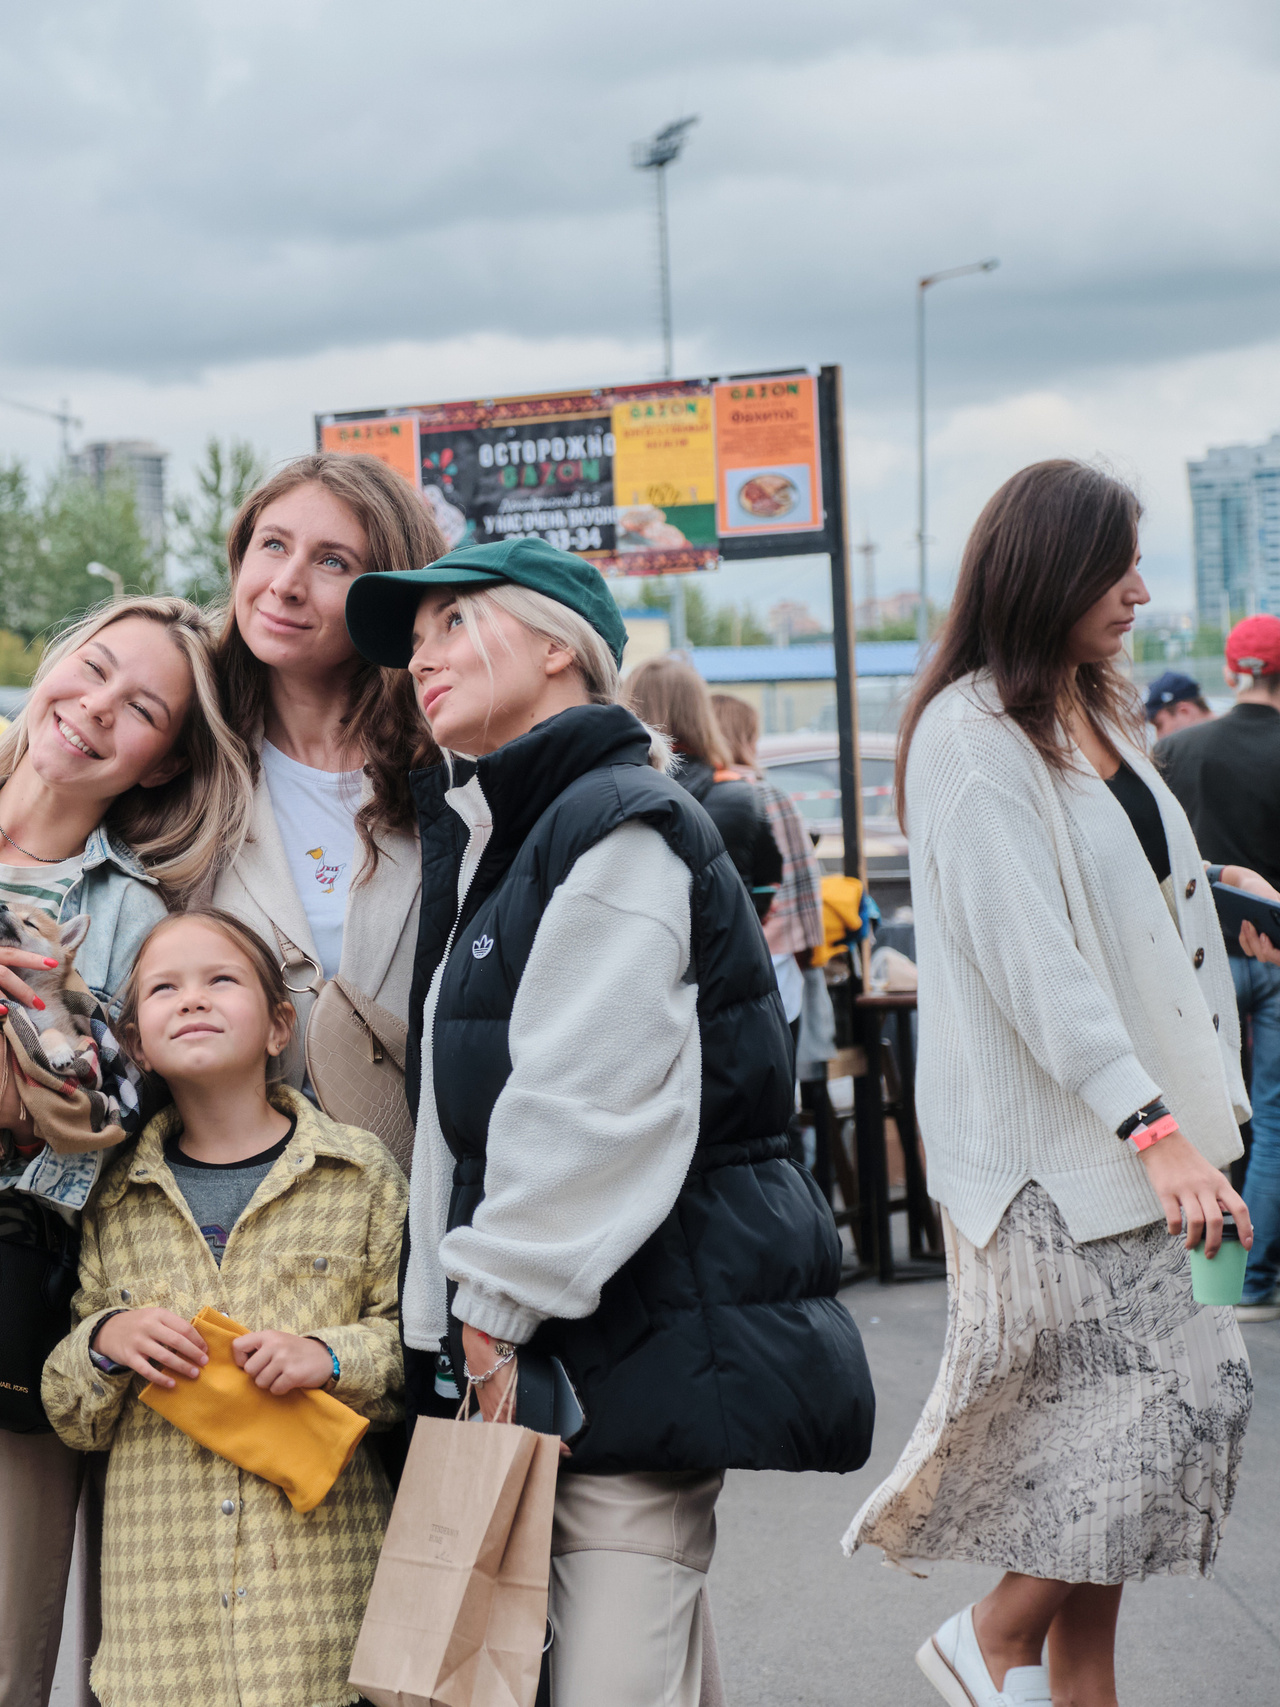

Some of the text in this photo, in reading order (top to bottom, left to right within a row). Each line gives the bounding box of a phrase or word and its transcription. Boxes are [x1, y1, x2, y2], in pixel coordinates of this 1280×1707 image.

[478, 432, 616, 468] ОСТОРОЖНО
[498, 460, 600, 487] GAZON
[495, 513, 522, 534] НАС
[522, 509, 567, 532] ОЧЕНЬ
[13, 1385, 29, 1394] KORS
